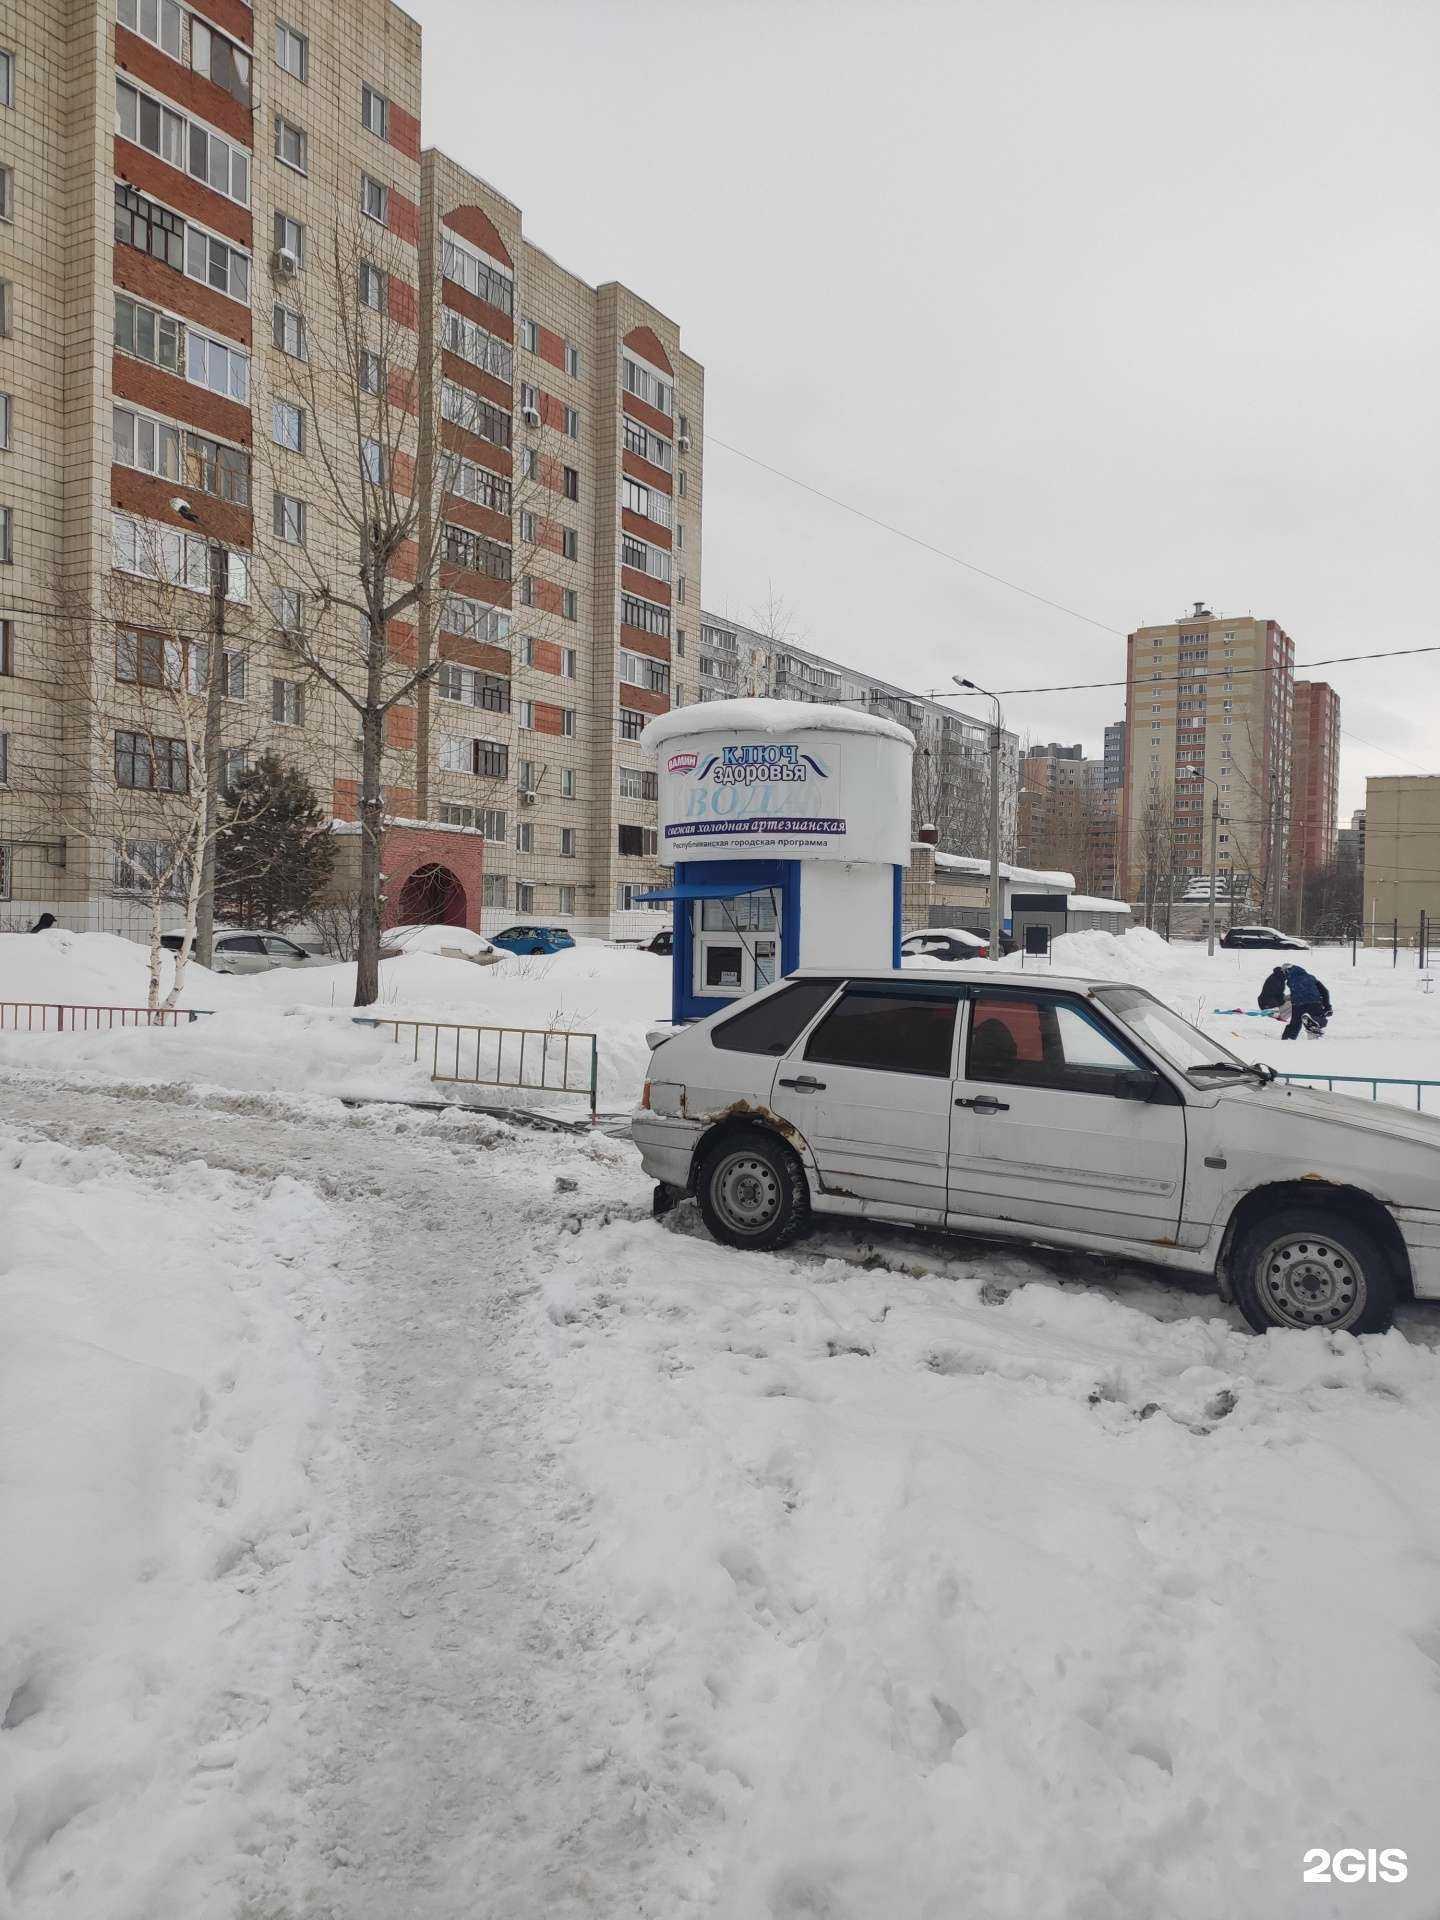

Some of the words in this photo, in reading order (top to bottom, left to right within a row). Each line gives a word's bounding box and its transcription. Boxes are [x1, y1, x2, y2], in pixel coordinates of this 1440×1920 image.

[668, 754, 697, 769] ВАМИН
[722, 745, 798, 765] КЛЮЧ
[667, 823, 696, 836] свежая
[697, 820, 750, 833] холодная
[750, 818, 845, 833] артезианская
[672, 839, 729, 850] Республиканская
[730, 838, 775, 848] городская
[778, 839, 828, 848] программа
